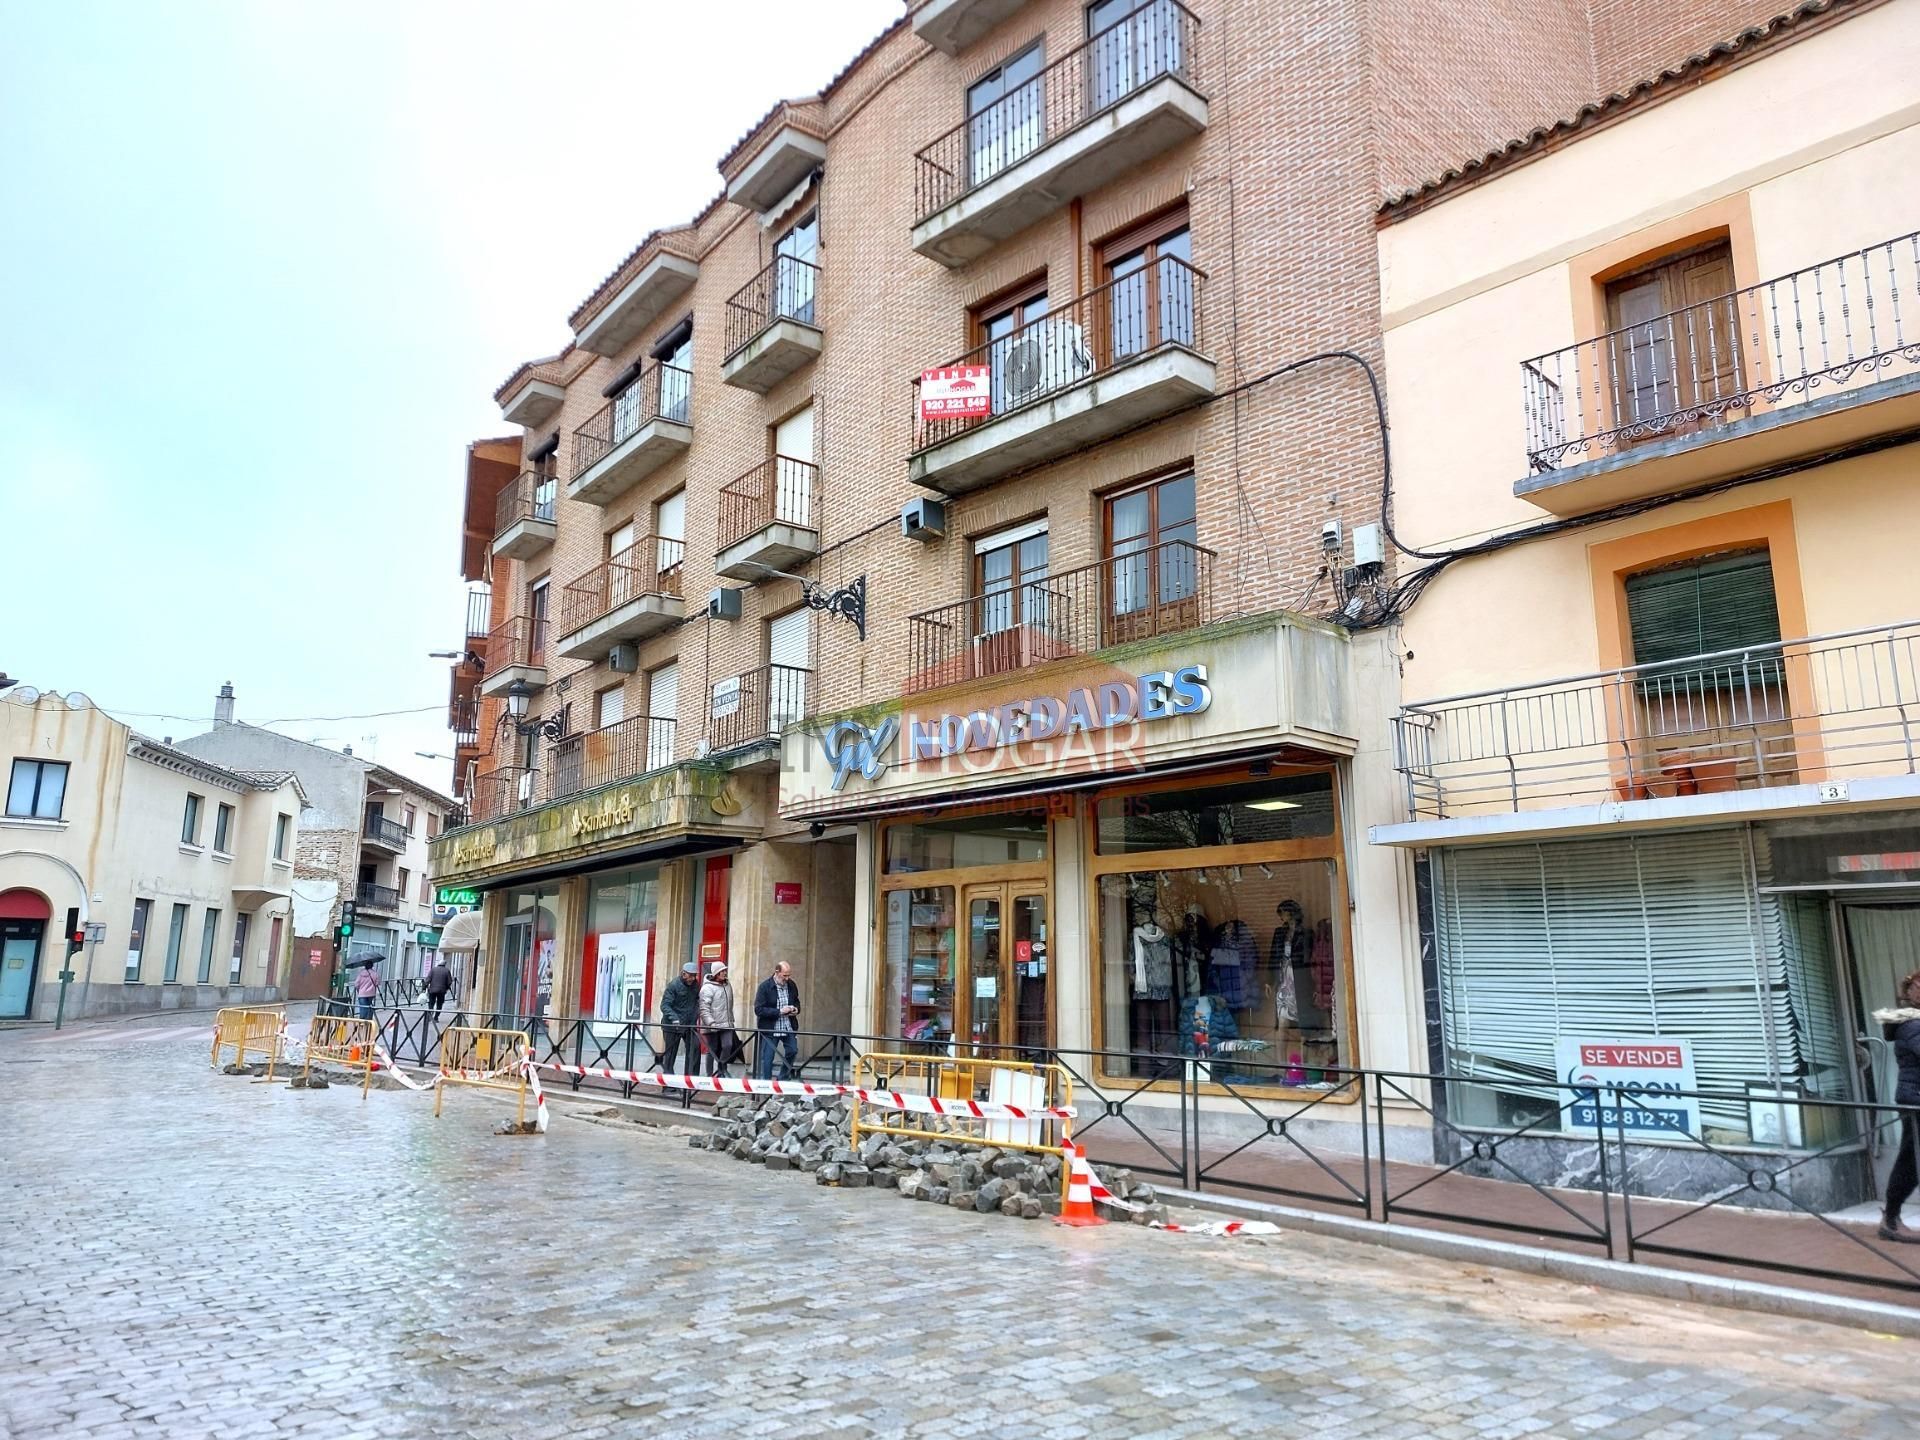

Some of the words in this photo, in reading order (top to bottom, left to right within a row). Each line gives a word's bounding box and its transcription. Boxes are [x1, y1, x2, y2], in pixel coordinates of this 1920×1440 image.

[925, 399, 945, 410] 920
[946, 398, 966, 409] 221
[911, 664, 1212, 761] NOVEDADES
[1828, 787, 1839, 798] 3
[581, 806, 634, 834] Santander
[1585, 1049, 1608, 1064] SE
[1612, 1050, 1679, 1065] VENDE
[1606, 1080, 1682, 1100] MOON
[1637, 1111, 1656, 1126] 12
